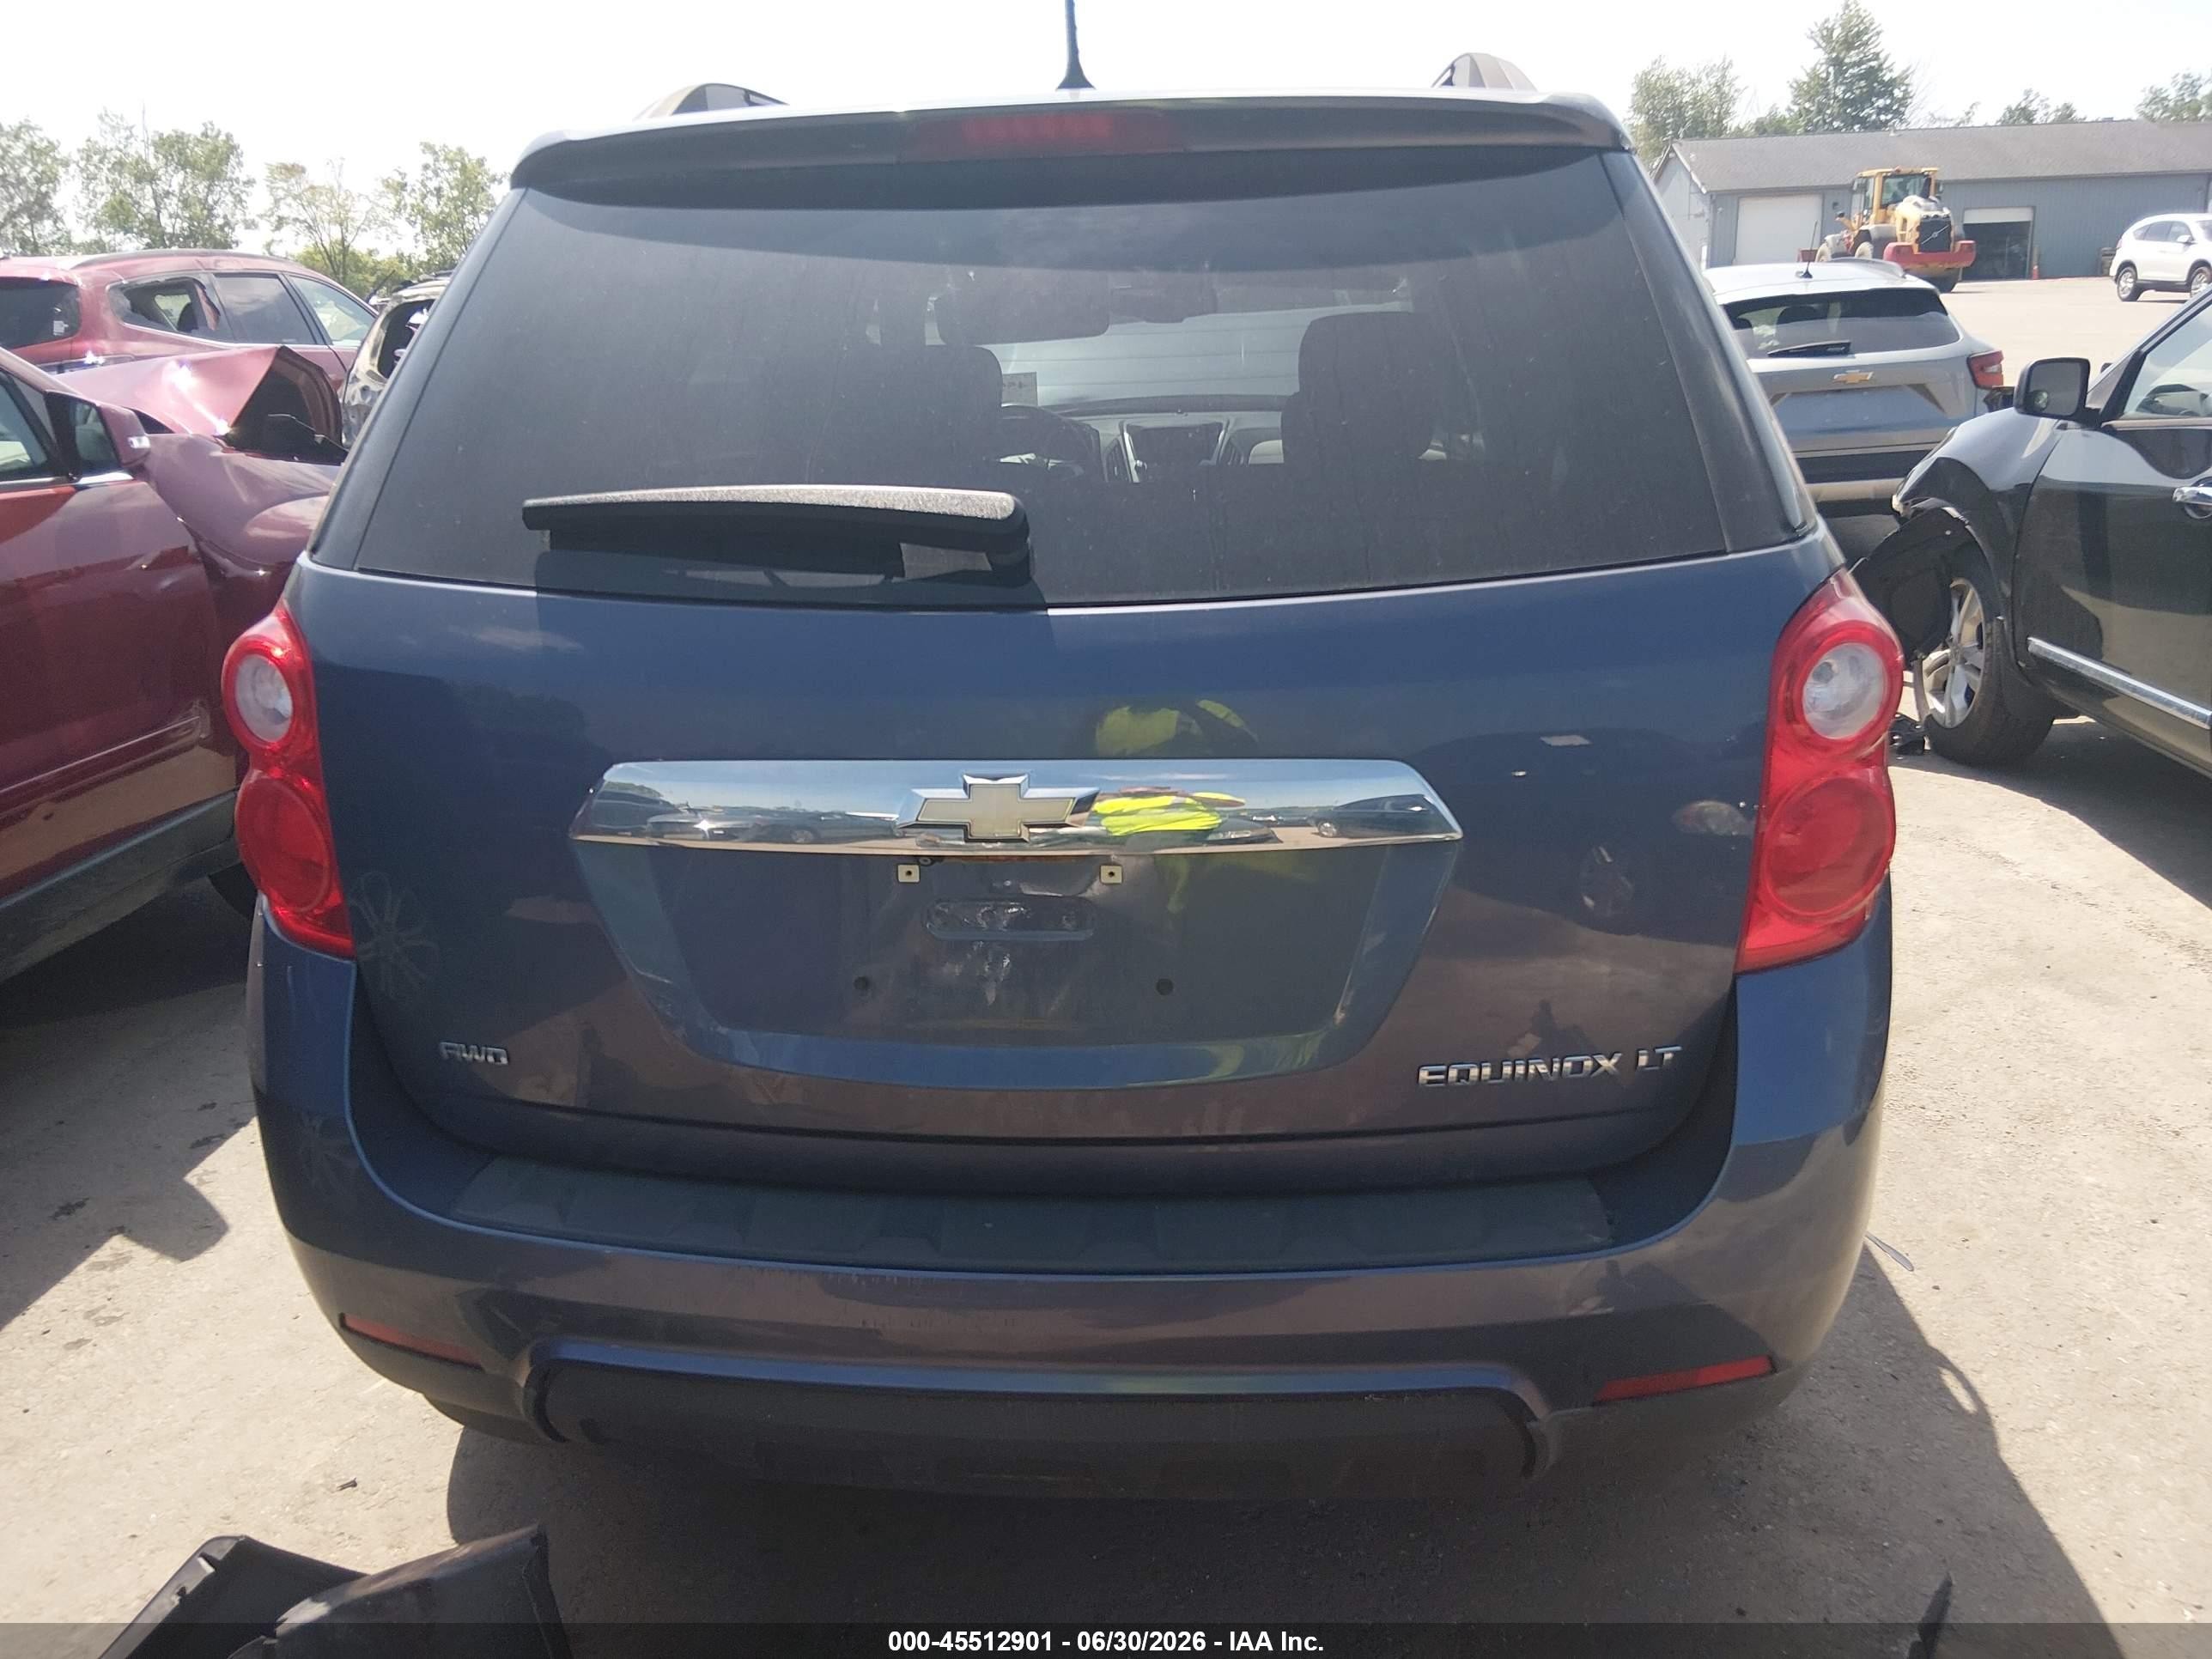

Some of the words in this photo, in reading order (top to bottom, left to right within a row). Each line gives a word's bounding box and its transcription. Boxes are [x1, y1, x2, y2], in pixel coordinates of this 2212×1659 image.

[439, 1042, 508, 1066] AWD
[1418, 1052, 1622, 1087] EQUINOX
[1636, 1045, 1682, 1072] LT
